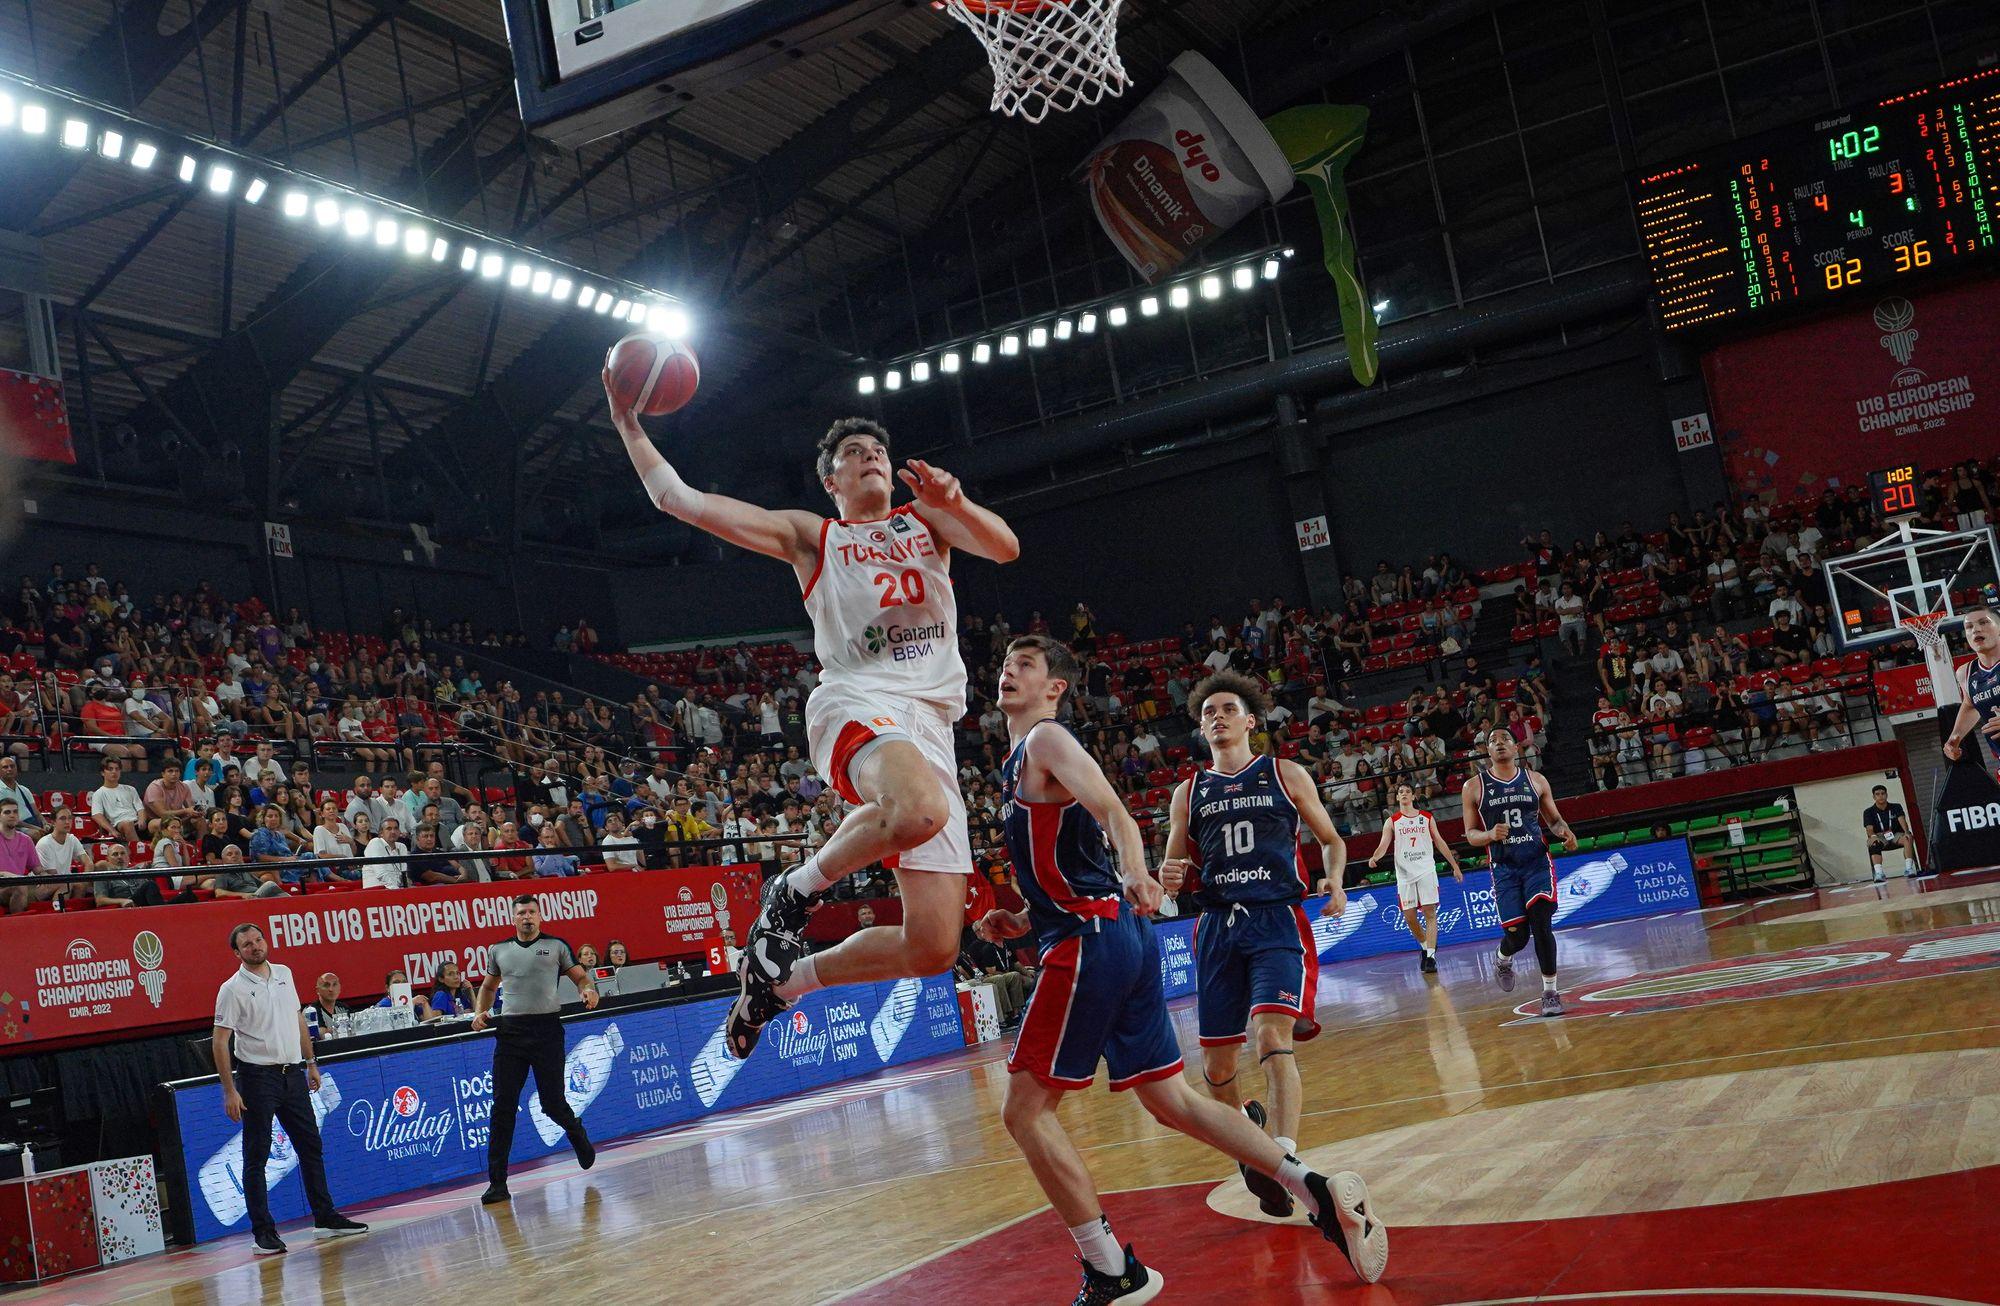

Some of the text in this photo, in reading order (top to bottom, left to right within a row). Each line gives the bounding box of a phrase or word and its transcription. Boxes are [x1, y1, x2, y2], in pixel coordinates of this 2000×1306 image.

[1918, 114, 1925, 125] 2
[1936, 109, 1943, 119] 3
[1953, 104, 1961, 113] 4
[1921, 125, 1928, 137] 2
[1936, 121, 1946, 132] 14
[1957, 115, 1964, 127] 5
[1942, 132, 1949, 143] 3
[1960, 127, 1967, 138] 6
[1829, 126, 1879, 161] 1:02
[1926, 139, 1970, 160] 2 2 7
[1176, 129, 1220, 182] dyo
[1948, 156, 1955, 167] 3
[1965, 151, 1972, 162] 8
[1742, 159, 1768, 175] 10 2
[1833, 160, 1854, 172] TIME
[1868, 159, 1901, 179] FAUL/SET
[1133, 154, 1184, 222] Dinamik
[1730, 176, 1754, 191] 3 4
[1793, 180, 1825, 200] FAUL/SET
[1889, 172, 1903, 193] 3
[1953, 180, 1960, 191] 6
[1968, 175, 1979, 186] 10
[1732, 193, 1740, 201] 4
[1749, 187, 1757, 198] 5
[1814, 194, 1828, 211] 4
[1938, 187, 1982, 208] 3 2 11
[1735, 199, 1759, 214] 5 10
[1974, 199, 1984, 210] 12
[1738, 205, 1779, 224] 7 2 3
[1849, 209, 1864, 227] 4
[1977, 210, 1987, 222] 13
[1741, 216, 1781, 237] 9 2
[1847, 227, 1873, 240] PERIOD
[1946, 223, 1990, 244] 2 14
[1741, 233, 1767, 249] 10 10
[1882, 229, 1916, 249] SCORE
[1967, 239, 1975, 251] 3
[1983, 235, 1993, 246] 17
[1743, 249, 1753, 260] 11
[1762, 244, 1770, 255] 8
[1746, 251, 1790, 272] 12 3 2
[1813, 247, 1846, 267] SCORE
[1894, 240, 1931, 272] 36
[1749, 272, 1758, 283] 17
[1768, 267, 1775, 278] 9
[1825, 258, 1861, 290] 82
[1748, 283, 1761, 296] 20
[1771, 280, 1778, 288] 4
[1750, 295, 1763, 308] 21
[1771, 291, 1780, 302] 17
[1898, 374, 1921, 387] FIBA
[1856, 376, 1970, 415] U18 EUROPEAN
[1859, 393, 1975, 432] CHAMPIONSHIP
[1682, 417, 1700, 432] B-1
[1924, 417, 1946, 430] 2022
[1678, 431, 1711, 447] BLOK
[1887, 466, 1913, 484] 1:02
[1882, 484, 1916, 512] 20
[1303, 520, 1320, 533] B-1
[1300, 532, 1328, 547] BLOK
[874, 568, 925, 609] 20
[887, 622, 944, 644] Garanti
[893, 641, 933, 661] BBVA
[1973, 689, 1992, 704] GREAT
[1200, 796, 1274, 817] GREAT BRITAIN
[1489, 795, 1533, 806] GREAT BRITAIN
[1503, 808, 1523, 828] 13
[1947, 803, 2000, 833] FIBA
[1221, 820, 1255, 857] 10
[1410, 837, 1417, 847] 7
[1215, 866, 1271, 884] indigofx
[1633, 861, 1676, 877] ADI DA
[1635, 874, 1686, 890] TADI DA
[1638, 885, 1689, 904] ULUDAĞ
[268, 889, 598, 949] FIBA U18 EUROPEAN CHAONSHIP
[664, 902, 712, 919] U18 EUROPEAN
[666, 916, 714, 933] CHAMPIONSHIP
[71, 947, 91, 960] FIBA
[710, 948, 721, 965] 5
[35, 959, 131, 986] U18 EUROPEAN
[38, 979, 135, 1008] CHAMPIONSHIP
[938, 986, 949, 999] DA
[93, 1003, 111, 1015] 2022
[829, 1002, 860, 1023] DOĞAL
[944, 1003, 956, 1016] DA
[833, 1021, 867, 1041] KAYNAK
[931, 1017, 959, 1038] ULUDAĞ
[630, 1042, 669, 1063] ADI DA
[837, 1043, 857, 1061] SUYU
[460, 1070, 494, 1099] DOĞ
[632, 1064, 679, 1086] TADI DA
[636, 1081, 682, 1109] ULUDAĞ
[348, 1098, 455, 1157] Uludağ
[388, 1141, 432, 1161] PREMIUM
